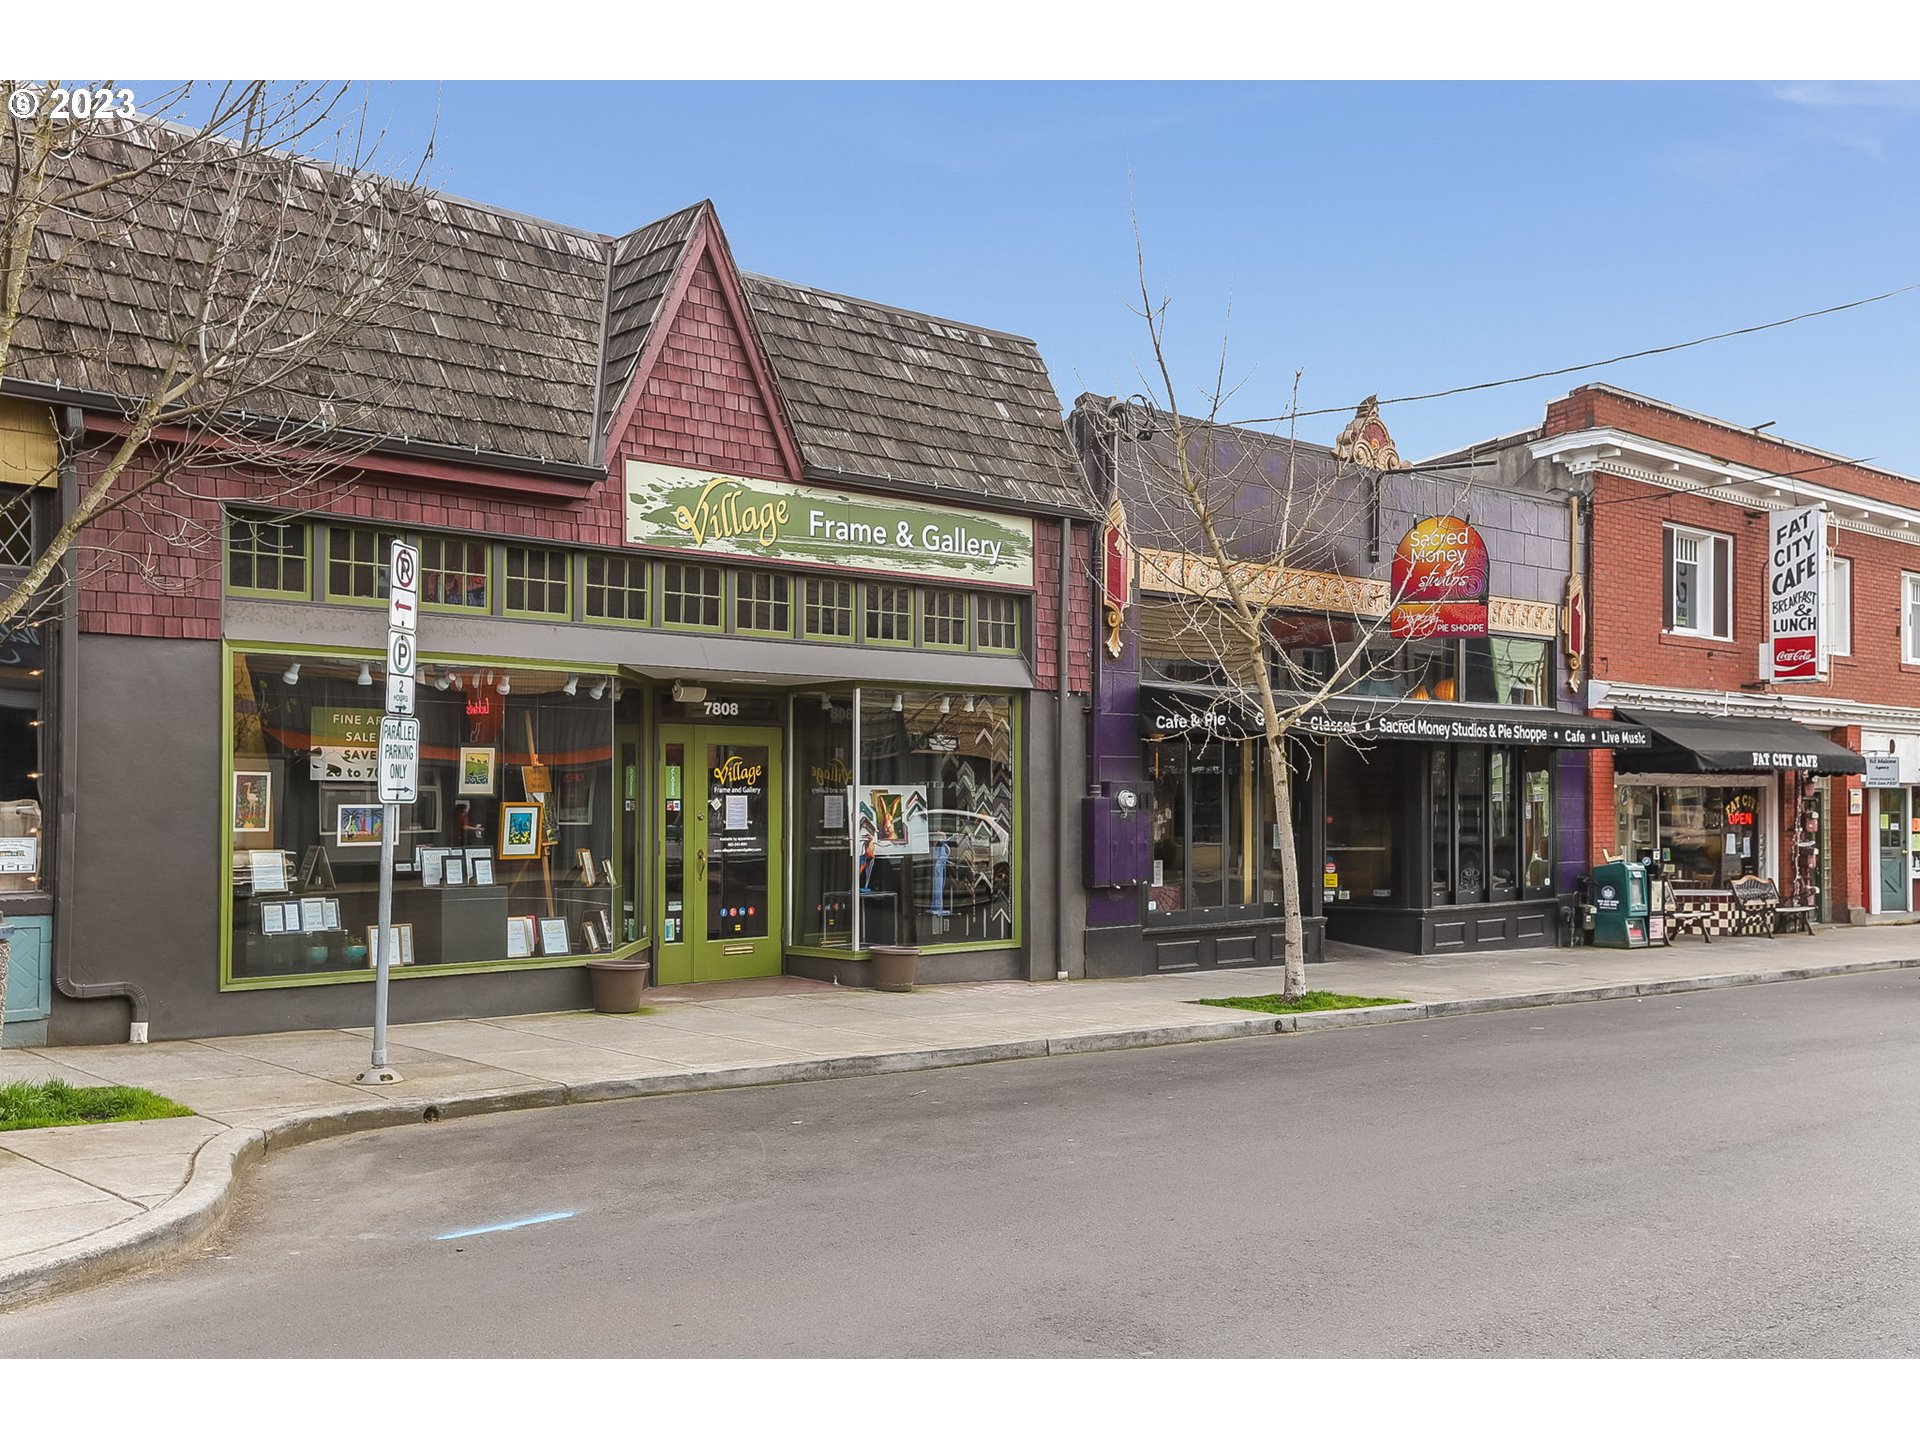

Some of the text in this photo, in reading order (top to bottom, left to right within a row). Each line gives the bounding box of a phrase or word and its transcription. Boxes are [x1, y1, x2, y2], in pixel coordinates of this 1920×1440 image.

[675, 477, 1004, 566] Village Frame & Gallery
[1776, 510, 1812, 546] FAT
[1410, 528, 1468, 547] Sacred
[1774, 529, 1815, 568] CITY
[1411, 549, 1467, 565] Money
[1772, 552, 1816, 596] CAFE
[1772, 590, 1817, 616] BREAKFAST
[1794, 603, 1813, 617] &
[1437, 624, 1484, 632] PIE SHOPPE
[1773, 616, 1817, 633] LUNCH
[1776, 649, 1812, 662] Coca-Cola
[398, 681, 404, 693] 2
[393, 694, 409, 703] HOURS
[703, 702, 739, 716] 7808
[333, 713, 382, 726] FINE AR
[1156, 711, 1227, 729] Cafe & Pie
[1310, 716, 1357, 733] Classes
[345, 731, 376, 743] SALE
[384, 724, 417, 741] PARALLEL
[1379, 717, 1548, 743] Sacred Money Studios & Pie Shoppe
[1564, 729, 1586, 743] Cafe
[1601, 730, 1646, 744] Live Music
[344, 750, 377, 761] SAVE
[385, 743, 414, 760] PARKING
[1752, 752, 1819, 768] FAT CITY CAFE
[346, 768, 361, 778] to
[389, 763, 408, 779] ONLY
[714, 756, 762, 785] Village
[713, 786, 761, 797] Frame and Gallery
[1725, 796, 1740, 814] FAT
[1728, 812, 1753, 825] OPEN
